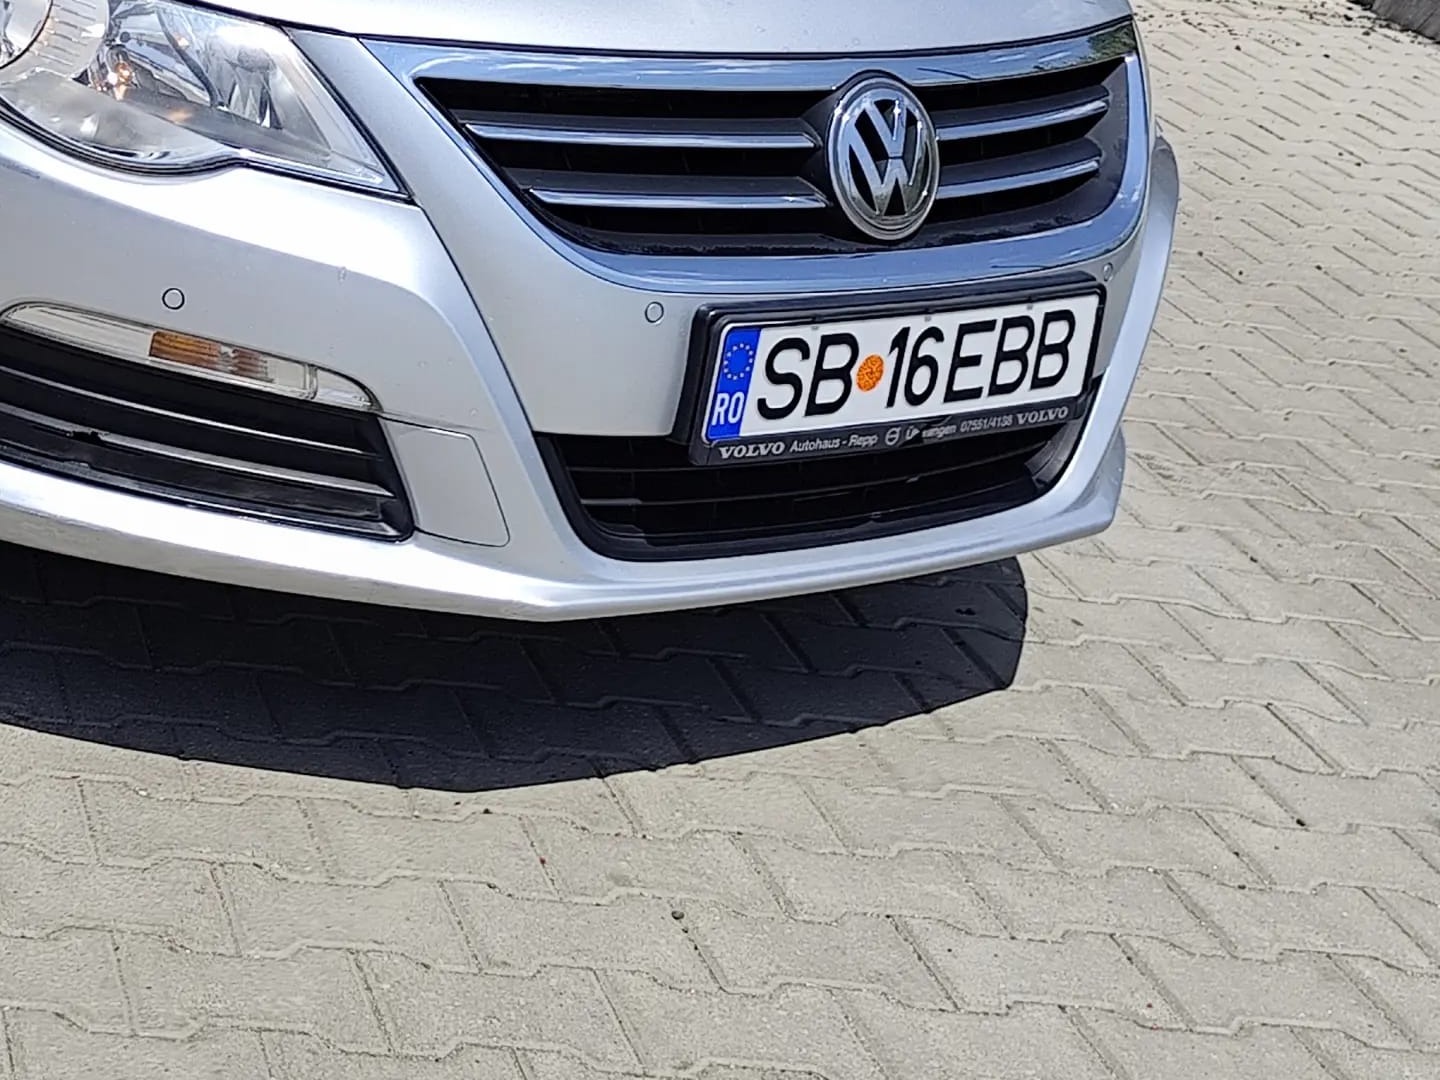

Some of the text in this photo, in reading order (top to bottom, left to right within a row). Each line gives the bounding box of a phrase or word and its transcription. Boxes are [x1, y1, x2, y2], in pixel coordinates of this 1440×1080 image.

[711, 391, 743, 427] RO
[718, 440, 786, 460] VOLVO
[789, 436, 842, 454] Autohaus
[1017, 405, 1069, 425] VOLVO
